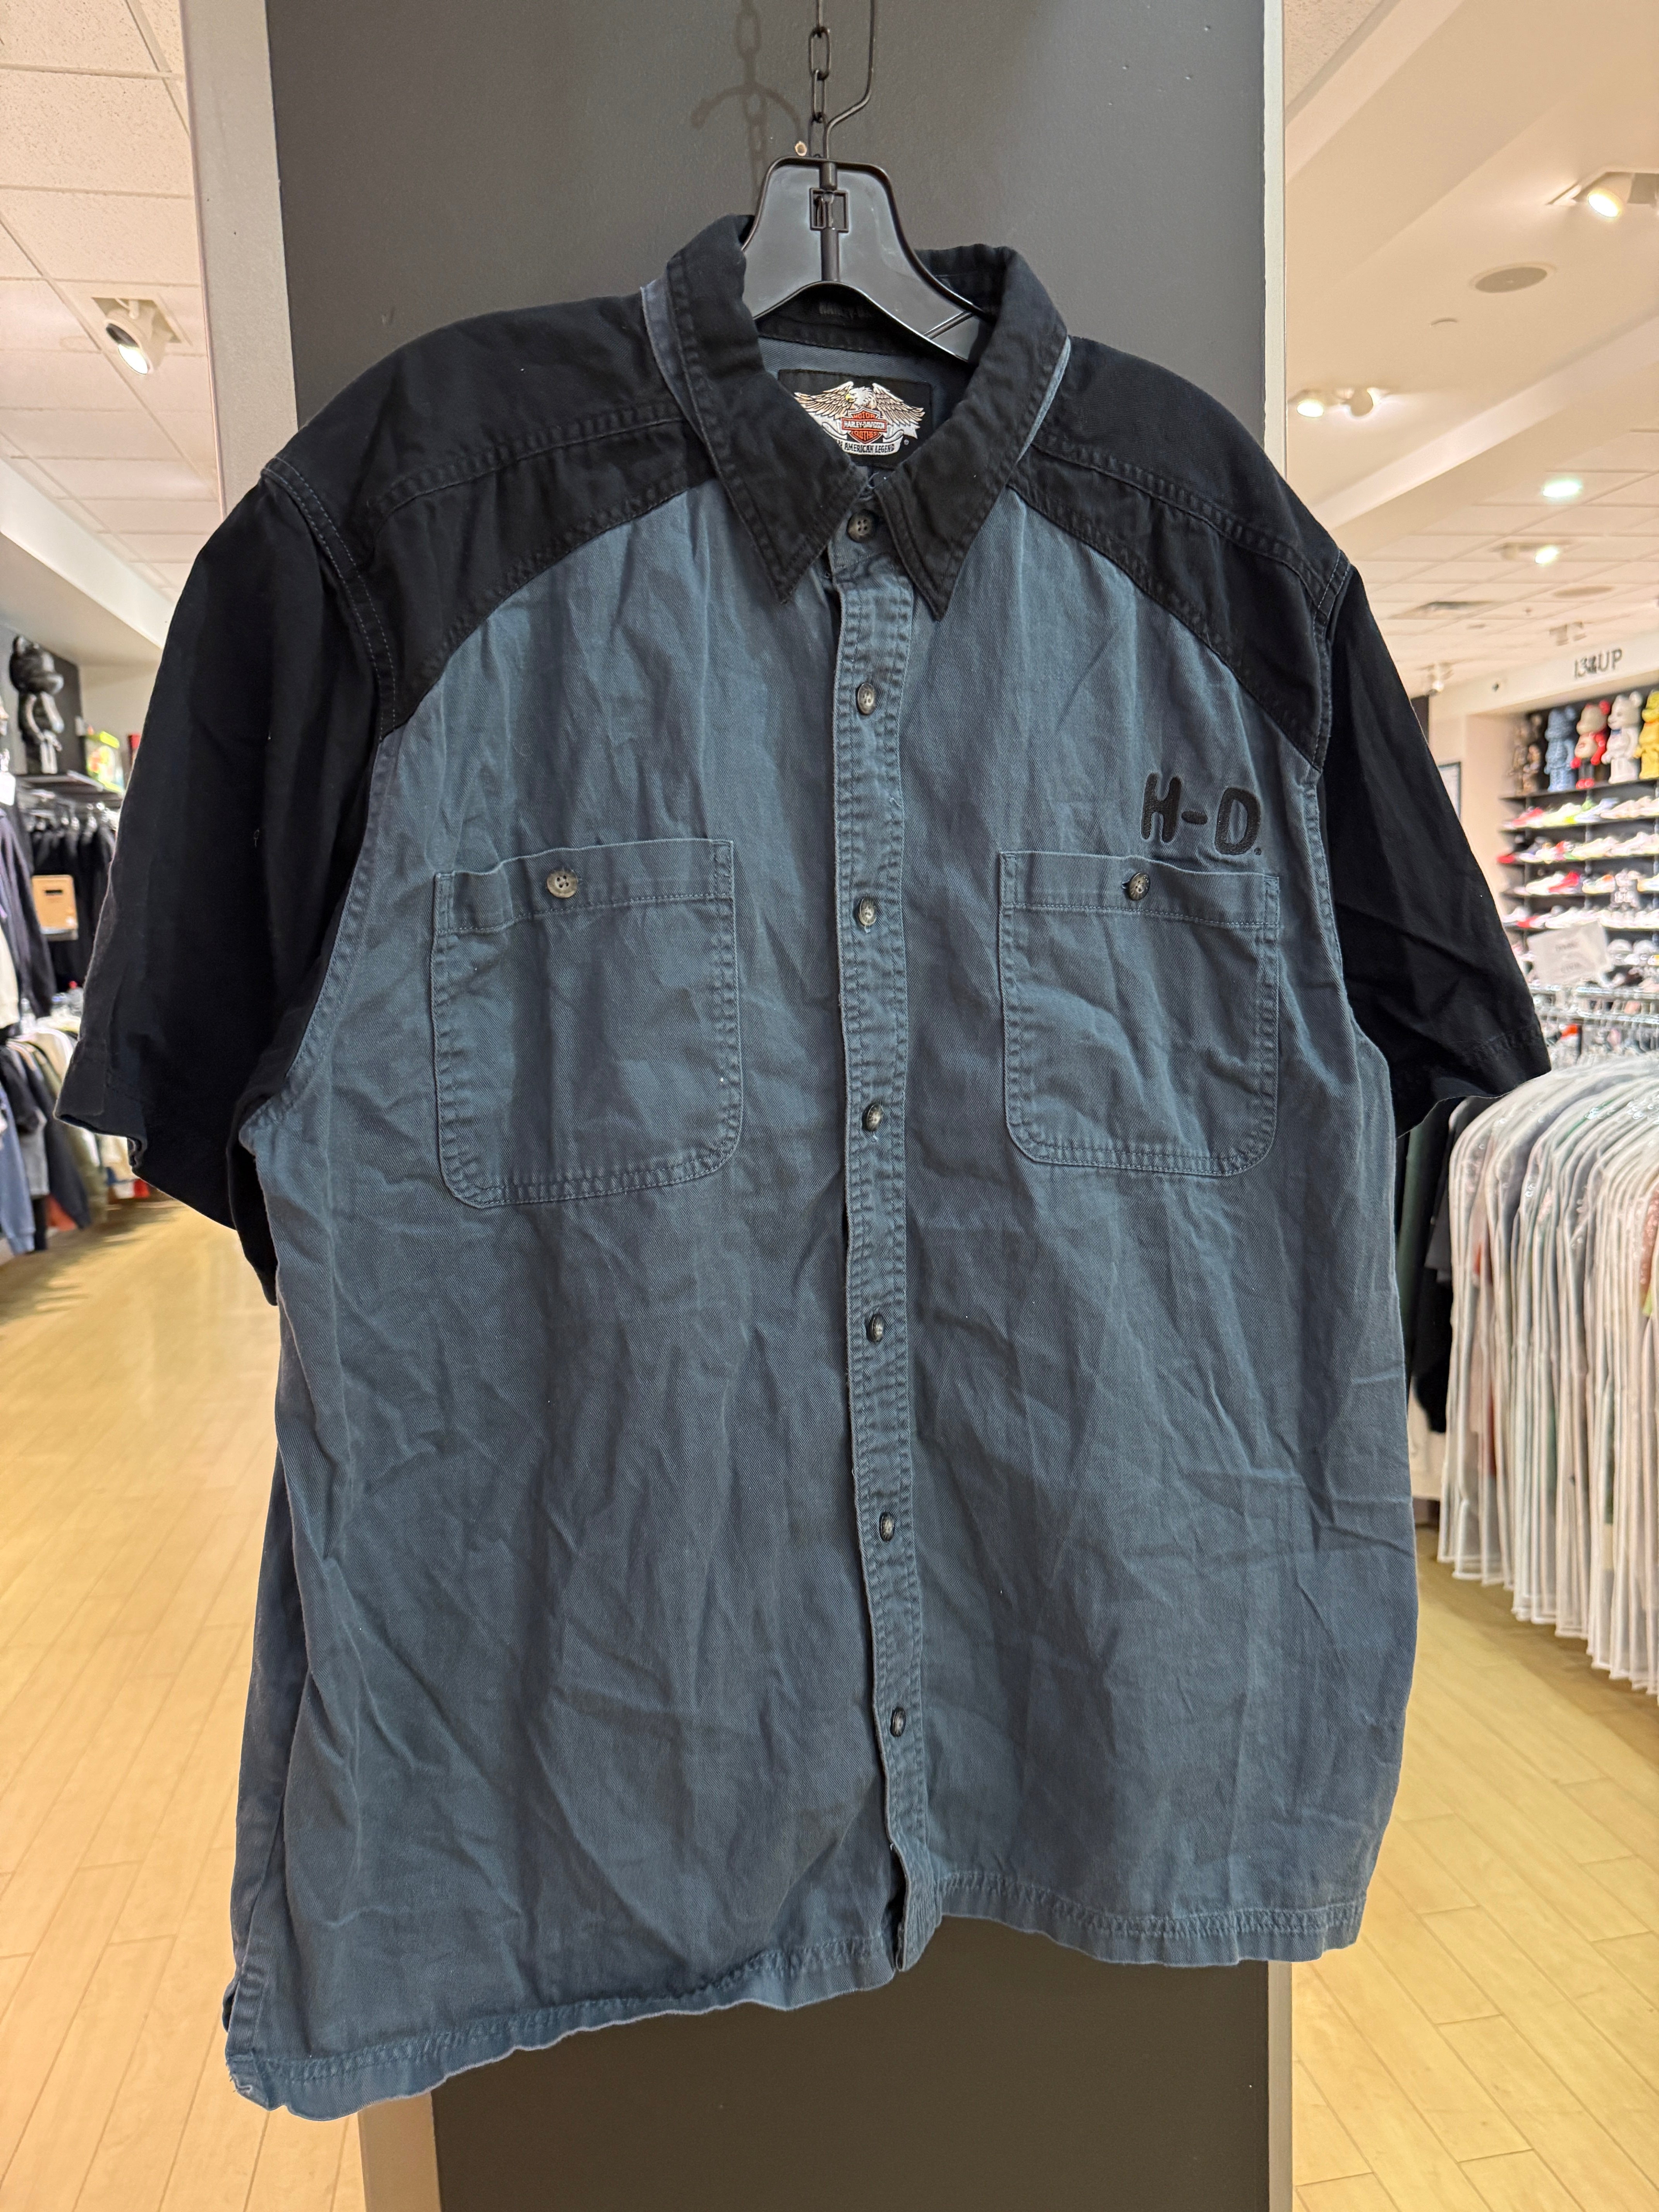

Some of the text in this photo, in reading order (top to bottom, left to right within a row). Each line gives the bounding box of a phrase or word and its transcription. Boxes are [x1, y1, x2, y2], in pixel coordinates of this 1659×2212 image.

[853, 411, 876, 419] MOTOR
[854, 431, 878, 440] CLOTHES
[844, 443, 874, 453] AMERICAN
[875, 443, 894, 453] LEGEND
